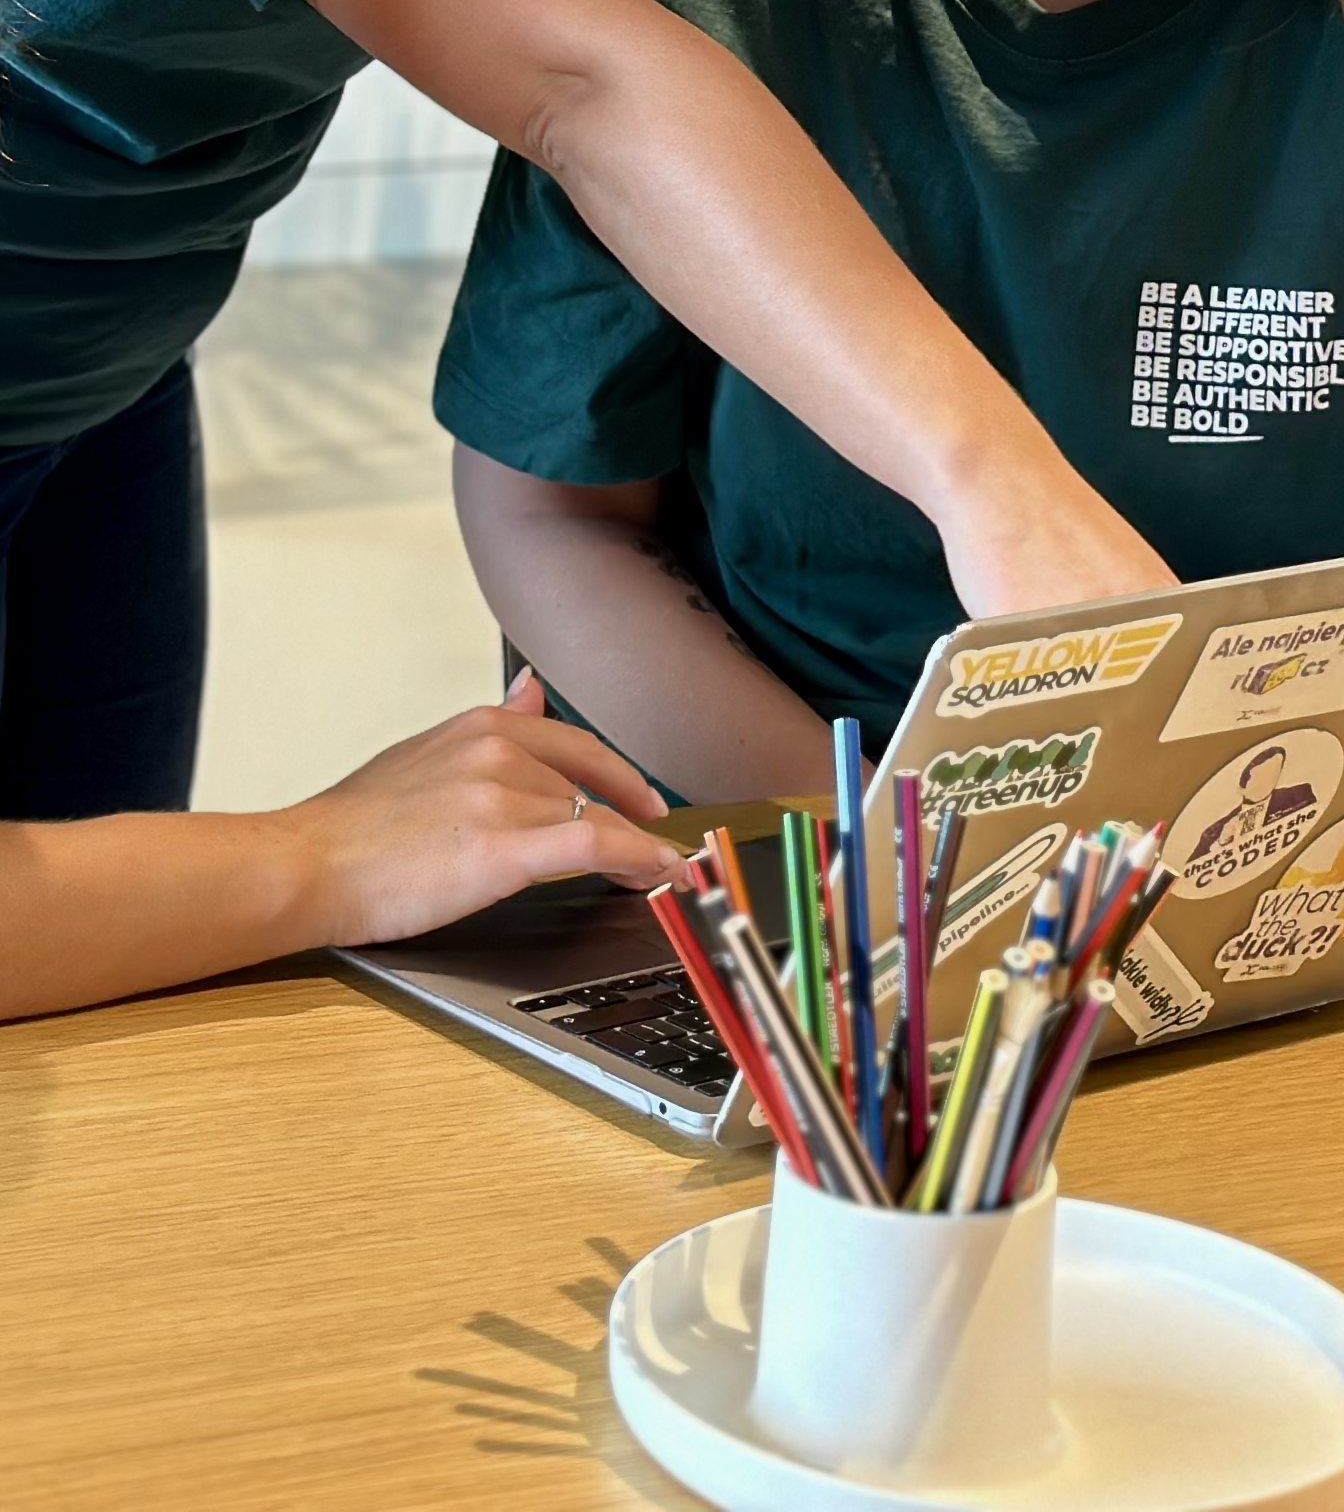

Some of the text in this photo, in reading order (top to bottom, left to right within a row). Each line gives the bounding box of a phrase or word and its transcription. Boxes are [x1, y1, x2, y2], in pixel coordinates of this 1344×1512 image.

[1141, 281, 1335, 314] BE A LEARNER
[1138, 306, 1326, 338] BE DIFFERENT
[1135, 330, 1172, 355] BE
[1133, 355, 1170, 379] BE
[1132, 380, 1330, 413] BE AUTHENTIC
[1130, 404, 1248, 435] BE BOLD
[961, 631, 1118, 688] YELLOW
[1210, 634, 1254, 660] Ale
[947, 663, 1099, 708] SQUADRON
[1184, 848, 1233, 879] that's
[1238, 824, 1283, 852] what
[1286, 809, 1317, 830] she
[1195, 828, 1300, 889] CODED
[1255, 915, 1297, 938] the
[1221, 925, 1340, 962] duck?!
